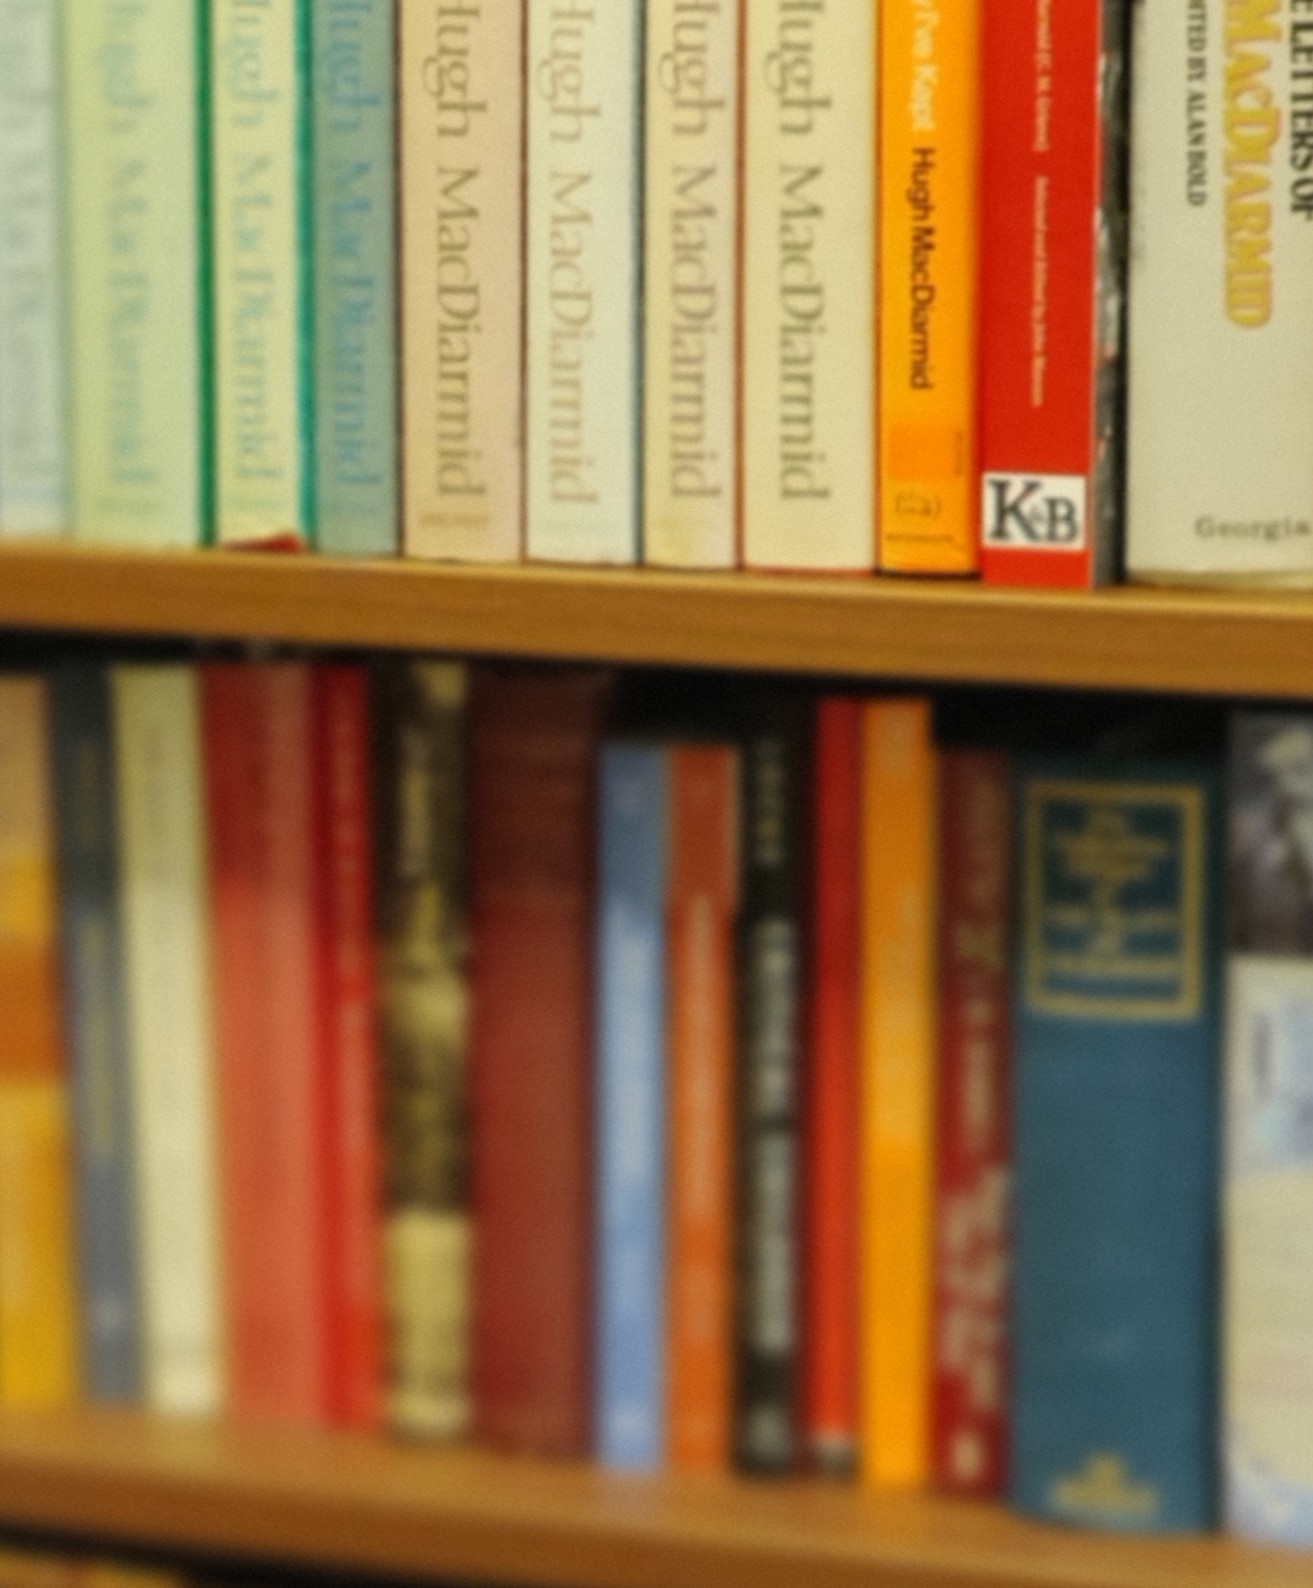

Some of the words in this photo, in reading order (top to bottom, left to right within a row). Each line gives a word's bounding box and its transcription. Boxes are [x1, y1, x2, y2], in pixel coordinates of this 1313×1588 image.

[905, 148, 937, 220] Hugh
[1187, 92, 1207, 147] ALAN
[1187, 151, 1207, 206] BOLD
[436, 163, 486, 496] MacDiarmid
[549, 170, 600, 505] MacDiarmid
[671, 163, 723, 498] MacDiarmid
[780, 163, 831, 500] MacDiarmid
[909, 226, 936, 389] MacDiarmid
